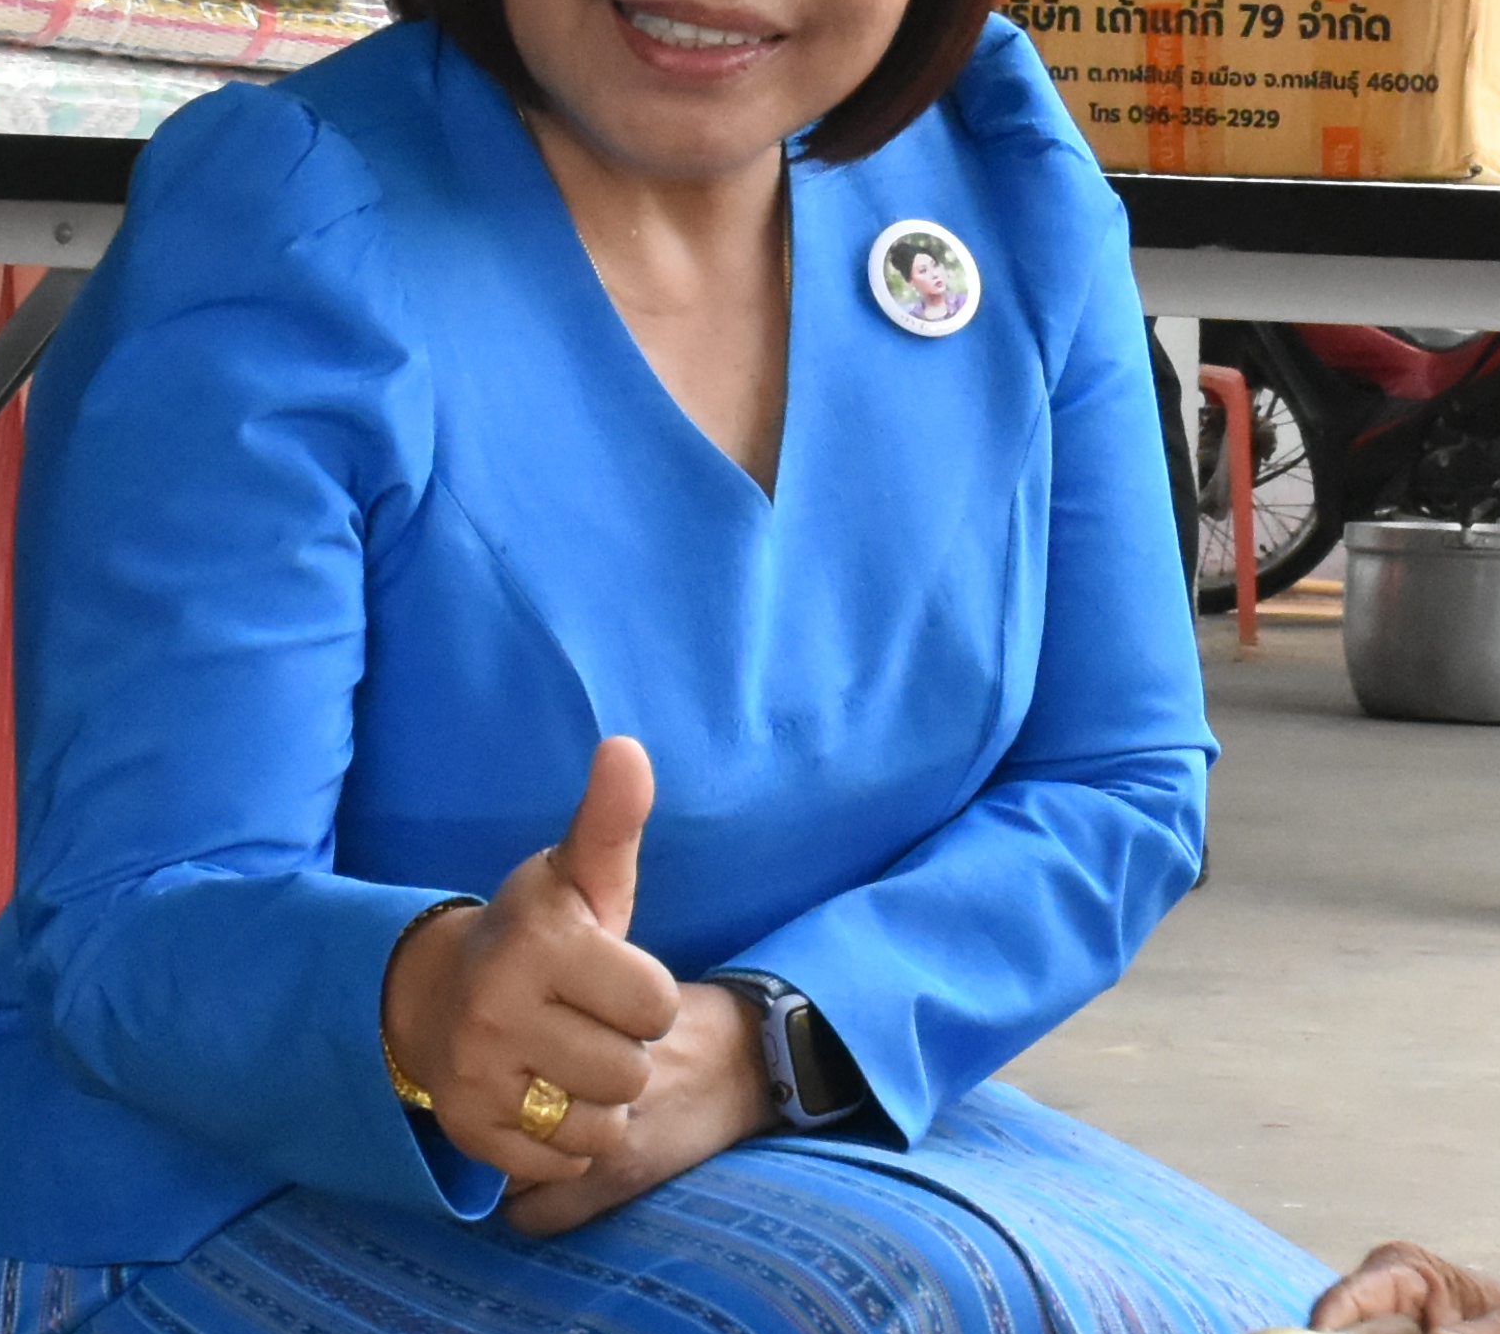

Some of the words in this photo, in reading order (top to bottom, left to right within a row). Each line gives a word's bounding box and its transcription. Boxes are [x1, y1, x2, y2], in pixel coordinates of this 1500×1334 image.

[1238, 3, 1284, 40] 79
[1298, 0, 1392, 43] จำกัด
[1366, 72, 1440, 94] 46000
[1088, 101, 1121, 124] โทร
[1128, 104, 1281, 129] 096-356-2929
